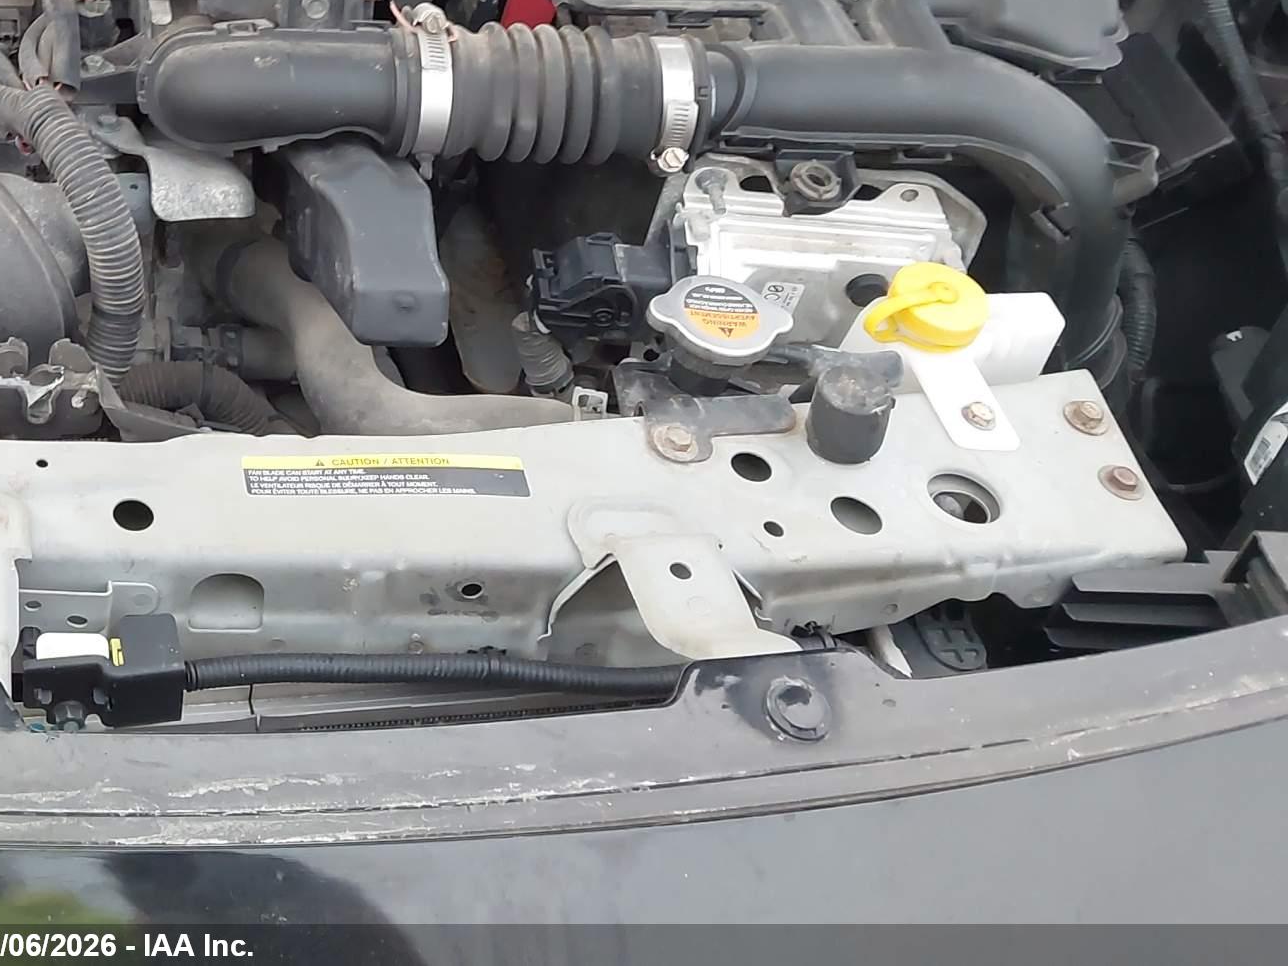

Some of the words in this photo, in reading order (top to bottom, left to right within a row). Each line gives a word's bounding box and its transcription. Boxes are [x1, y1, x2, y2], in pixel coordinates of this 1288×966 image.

[701, 319, 747, 327] WARNING
[331, 457, 379, 466] CAUTION
[391, 457, 450, 465] ATTENTION
